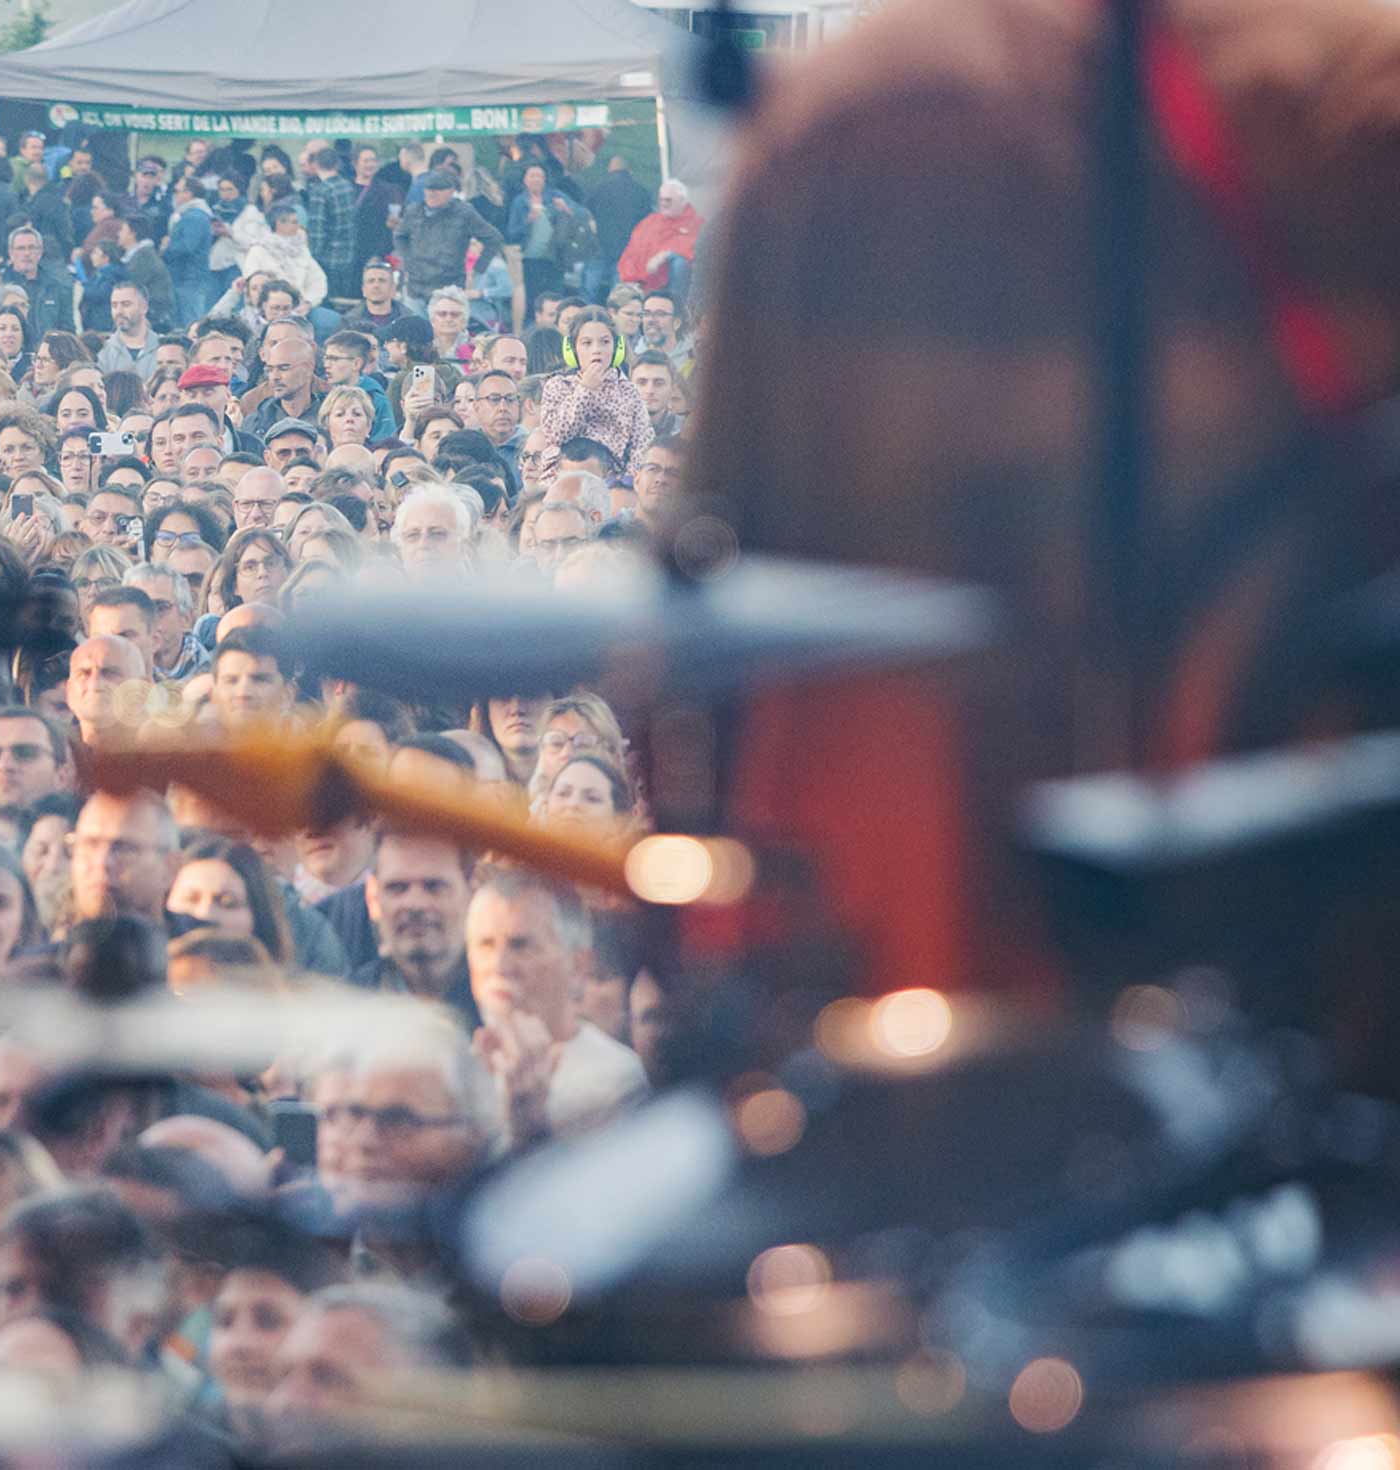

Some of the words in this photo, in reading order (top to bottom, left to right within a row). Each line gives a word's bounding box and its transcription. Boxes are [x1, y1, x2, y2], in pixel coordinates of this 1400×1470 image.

[122, 112, 155, 129] VOUS
[157, 112, 189, 131] SERT
[192, 114, 210, 131] DE
[211, 114, 230, 132] LA
[230, 114, 276, 133] VIANDE
[326, 114, 362, 133] LOCAL
[364, 113, 379, 133] ET
[381, 112, 433, 132] SURTOUT
[471, 108, 508, 129] BON
